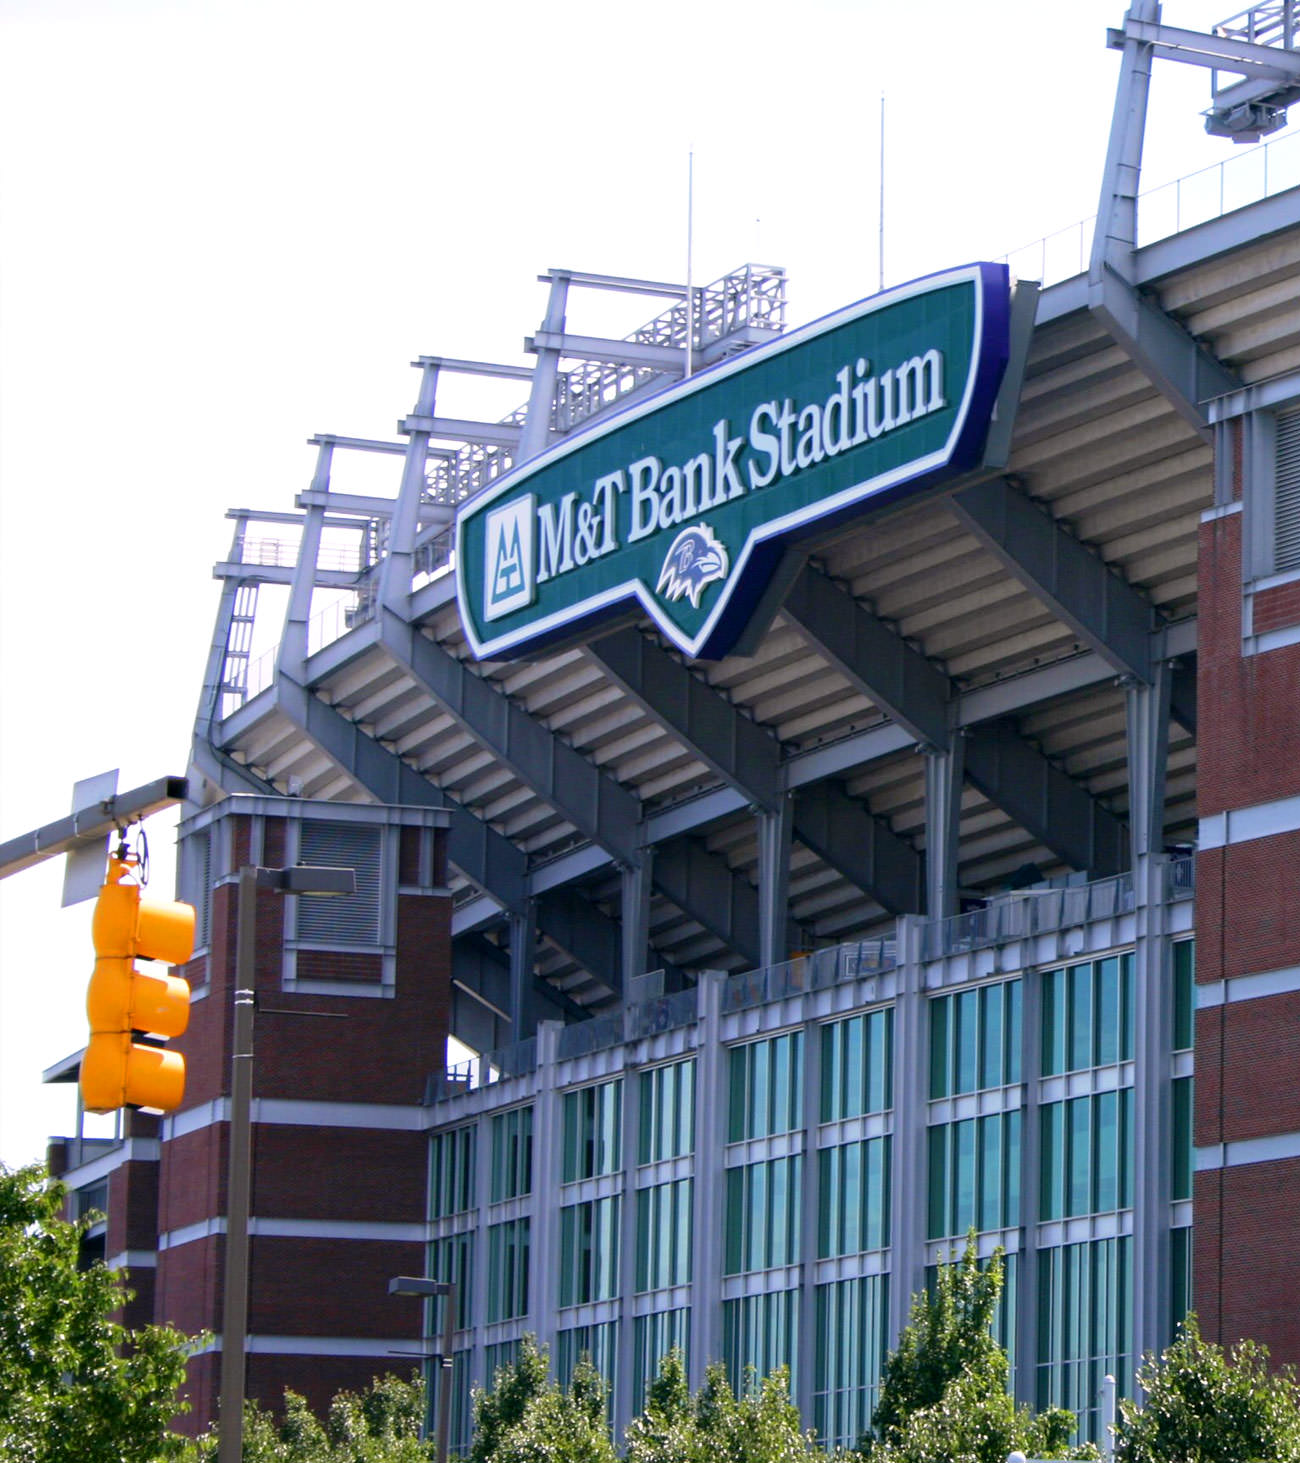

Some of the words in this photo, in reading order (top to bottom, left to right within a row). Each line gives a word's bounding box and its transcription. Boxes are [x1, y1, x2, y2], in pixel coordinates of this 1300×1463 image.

[537, 469, 628, 584] M&T
[629, 419, 746, 542] Bank
[748, 349, 947, 489] Stadium
